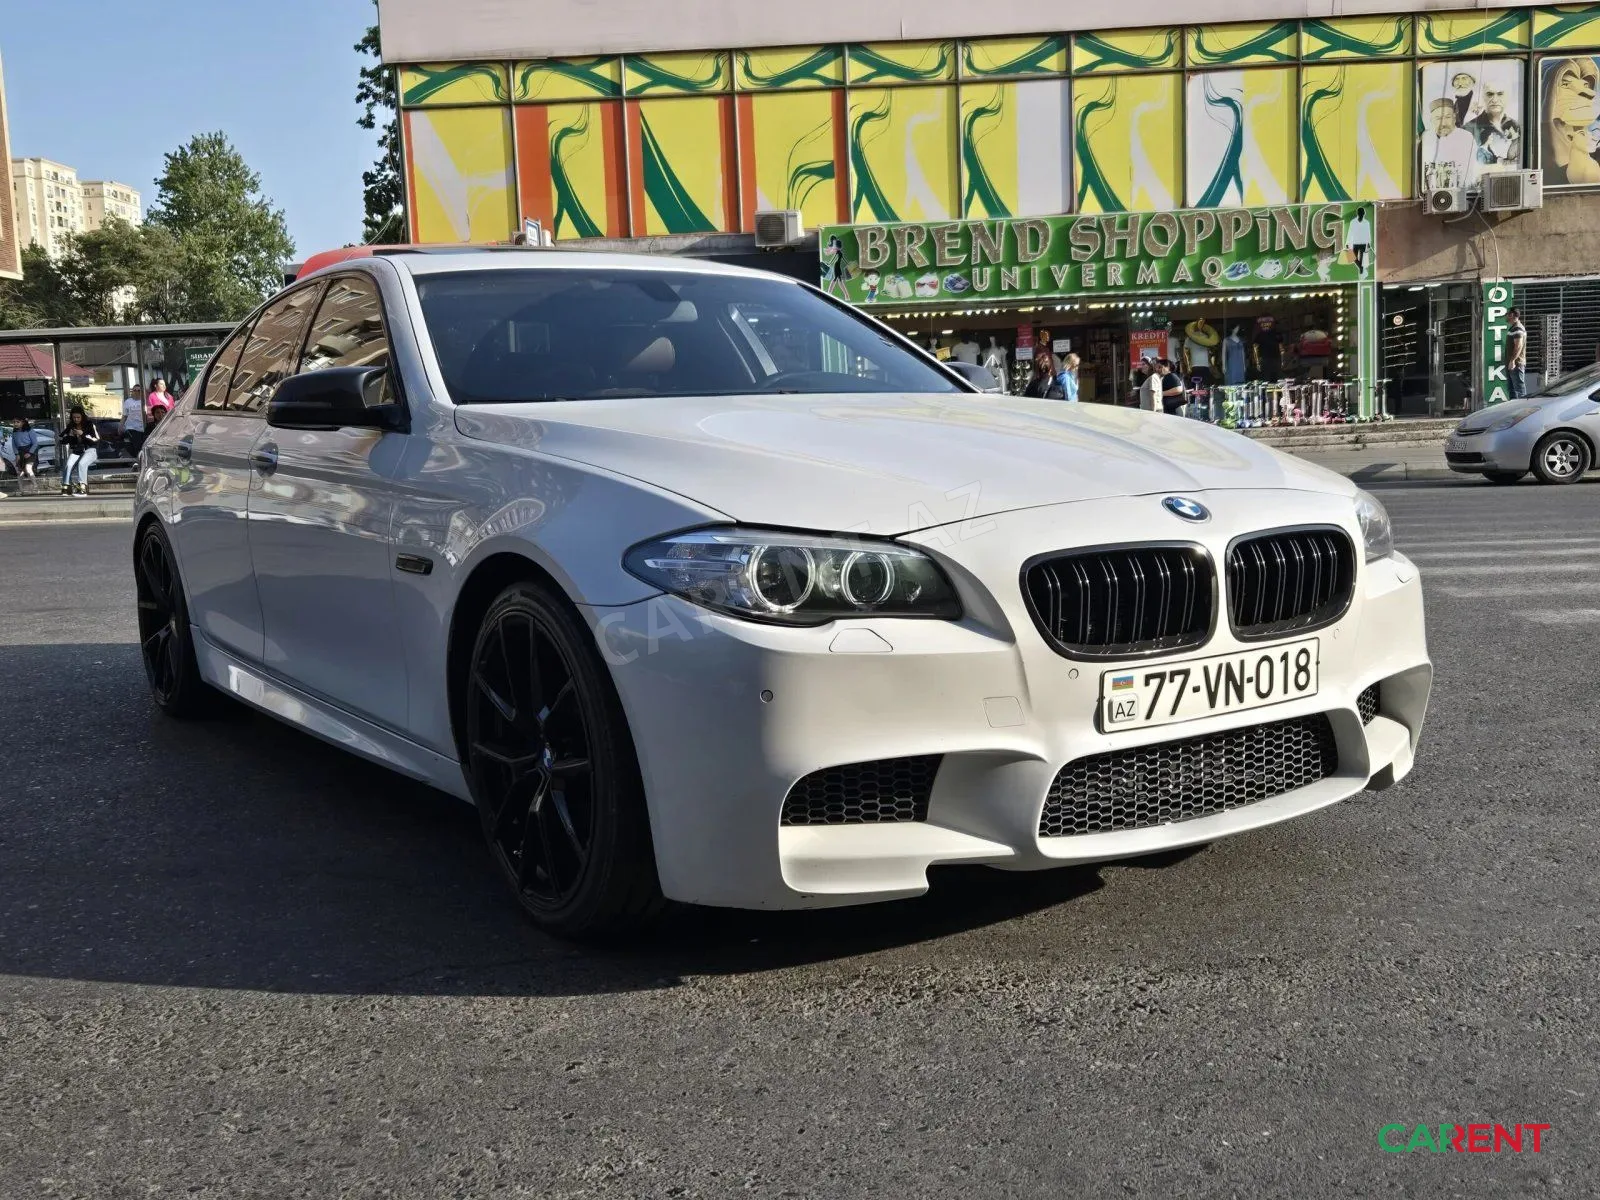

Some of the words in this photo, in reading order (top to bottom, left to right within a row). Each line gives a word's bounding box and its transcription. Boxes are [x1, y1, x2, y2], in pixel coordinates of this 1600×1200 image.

[853, 218, 1051, 270] BREND
[972, 256, 1223, 292] UNIVERMAQ
[1488, 287, 1508, 403] OPTIKA
[1115, 700, 1136, 719] AZ
[1144, 647, 1311, 721] 77-VN-018
